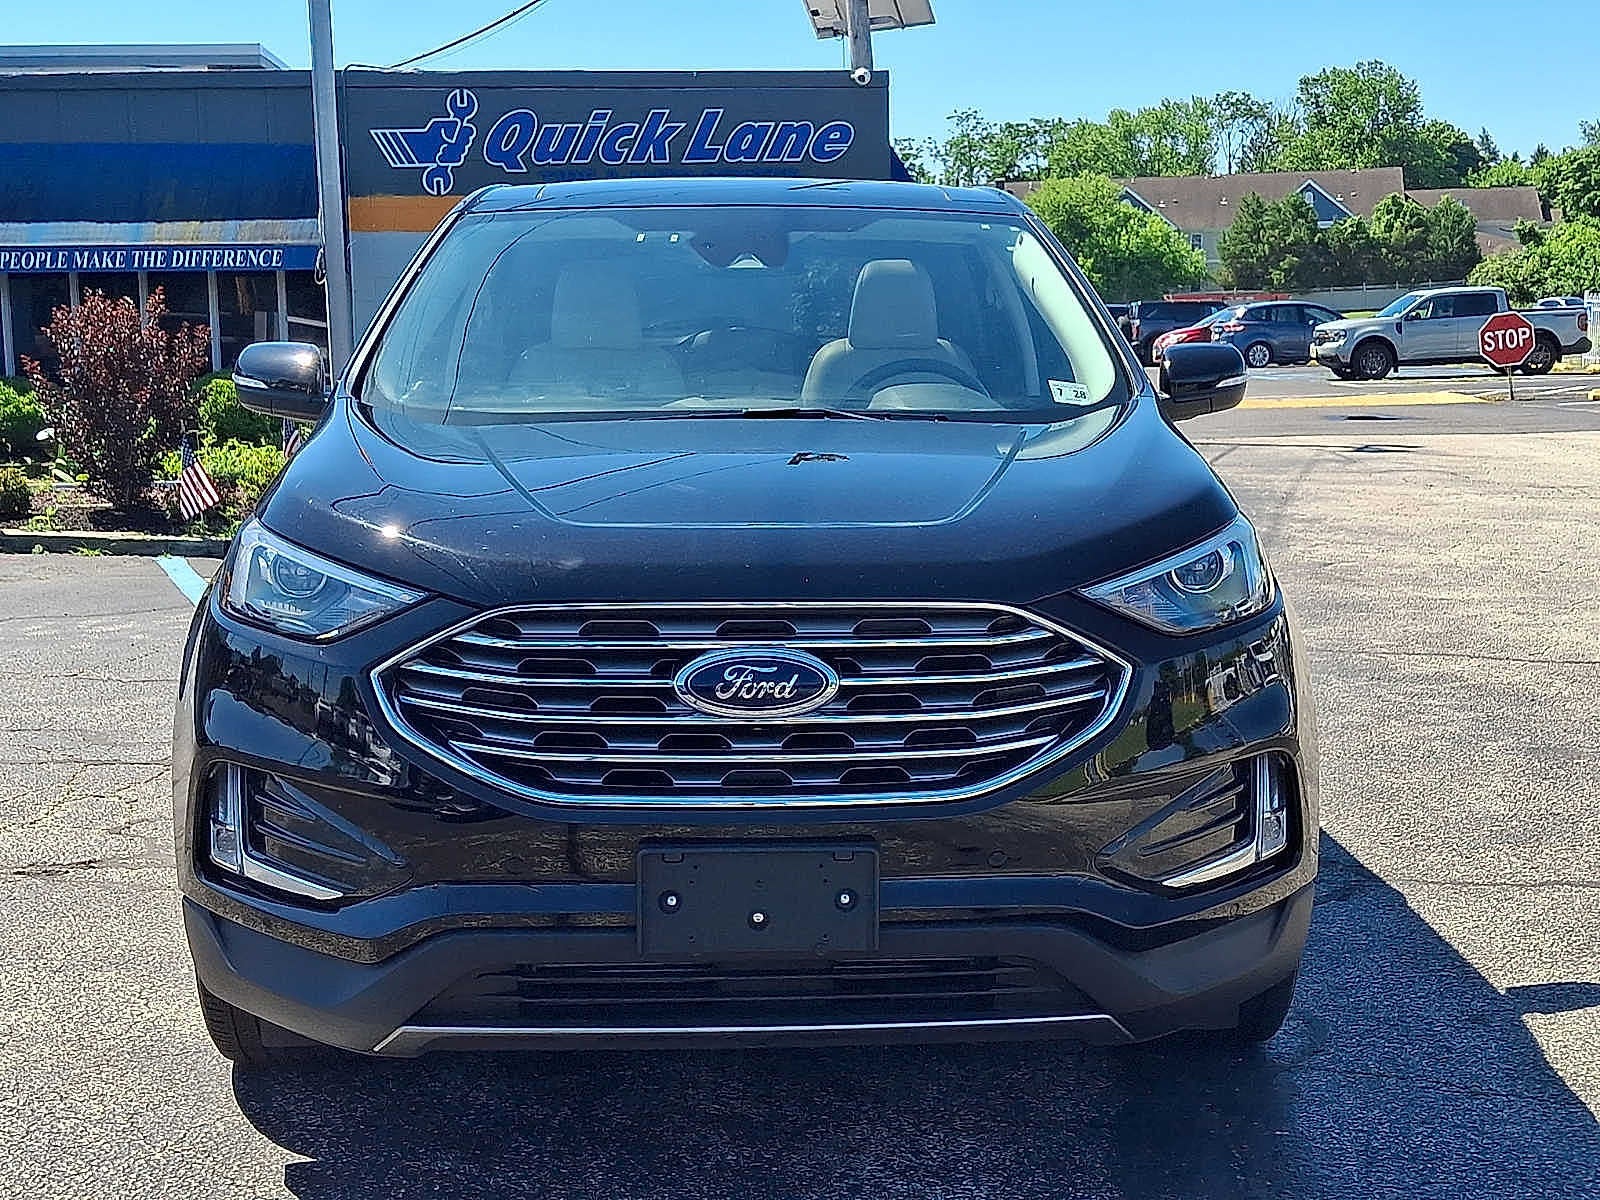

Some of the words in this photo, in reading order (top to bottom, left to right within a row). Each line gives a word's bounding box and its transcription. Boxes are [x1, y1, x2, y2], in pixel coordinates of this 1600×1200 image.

[483, 108, 687, 172] Quick
[682, 108, 855, 164] Lane
[0, 251, 68, 270] PEOPLE
[72, 250, 127, 269] MAKE
[132, 250, 167, 268] THE
[171, 249, 283, 268] DIFFERENCE
[1483, 327, 1530, 352] STOP
[1056, 387, 1063, 396] 7
[715, 664, 799, 700] Ford
